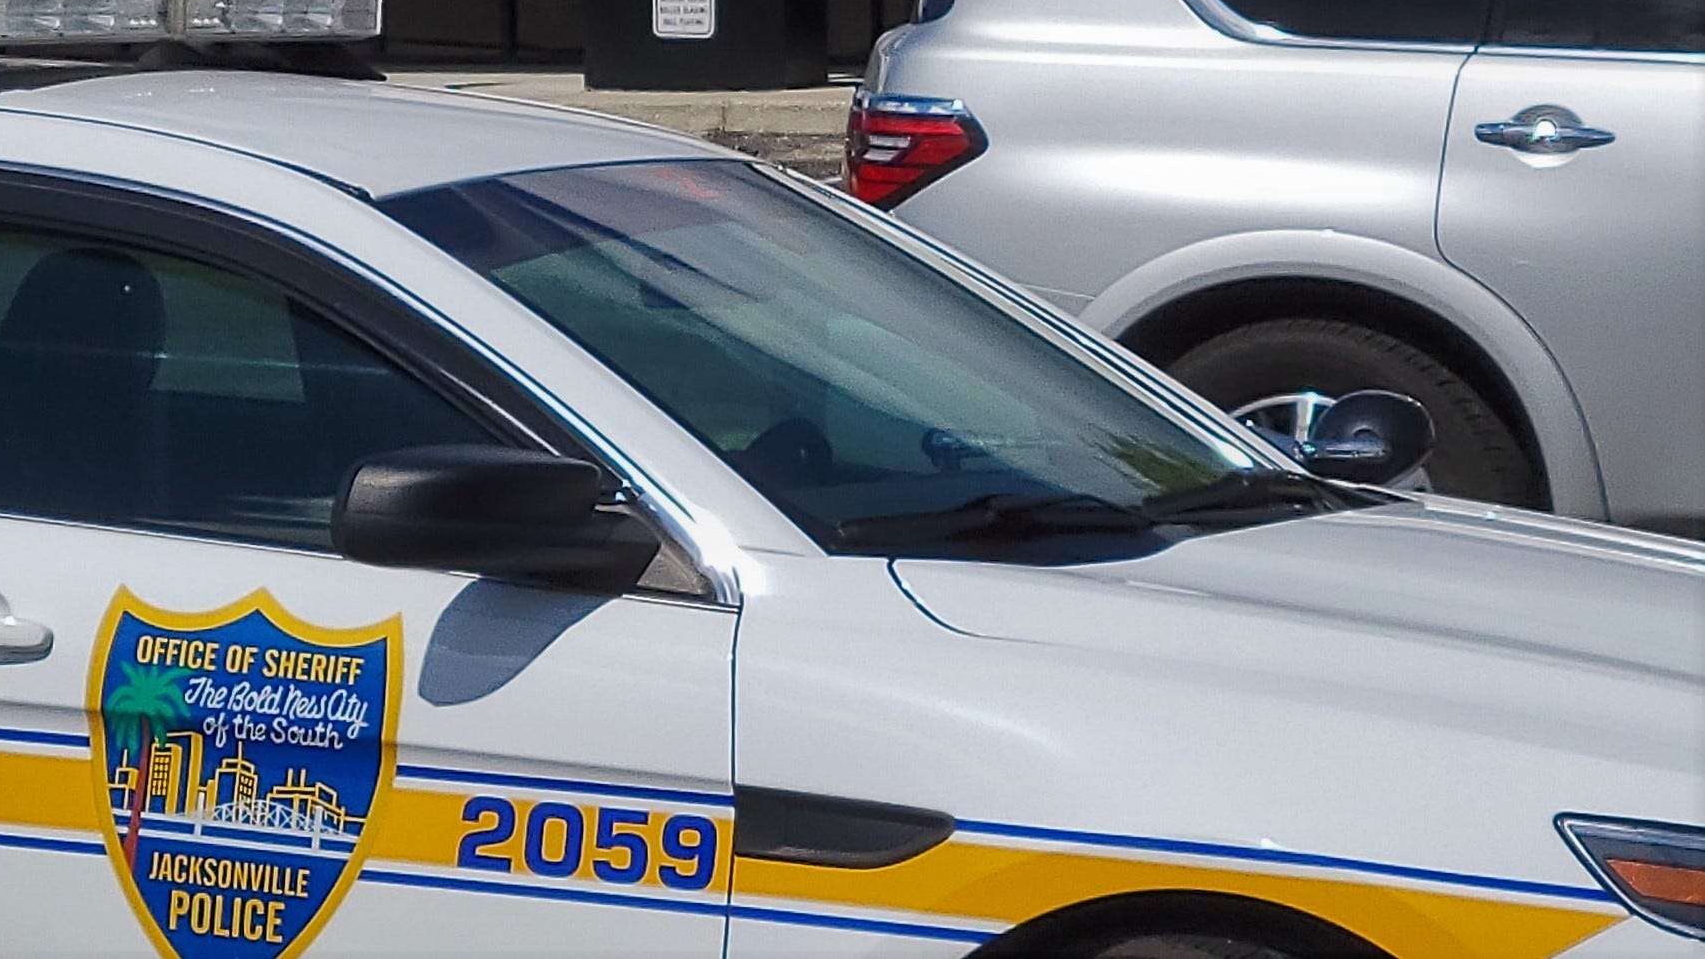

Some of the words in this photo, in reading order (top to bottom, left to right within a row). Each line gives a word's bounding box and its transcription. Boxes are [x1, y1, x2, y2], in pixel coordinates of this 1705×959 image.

[137, 635, 219, 671] OFFICE
[226, 644, 257, 674] OF
[262, 648, 364, 685] SHERIFF
[184, 677, 228, 709] The
[227, 681, 284, 715] Bold
[282, 684, 327, 720] New
[326, 689, 369, 740] City
[203, 712, 229, 748] of
[232, 714, 267, 741] the
[270, 717, 344, 750] South
[457, 795, 717, 891] 2059
[150, 851, 310, 898] JACKSONVILLE
[169, 889, 286, 943] POLICE
